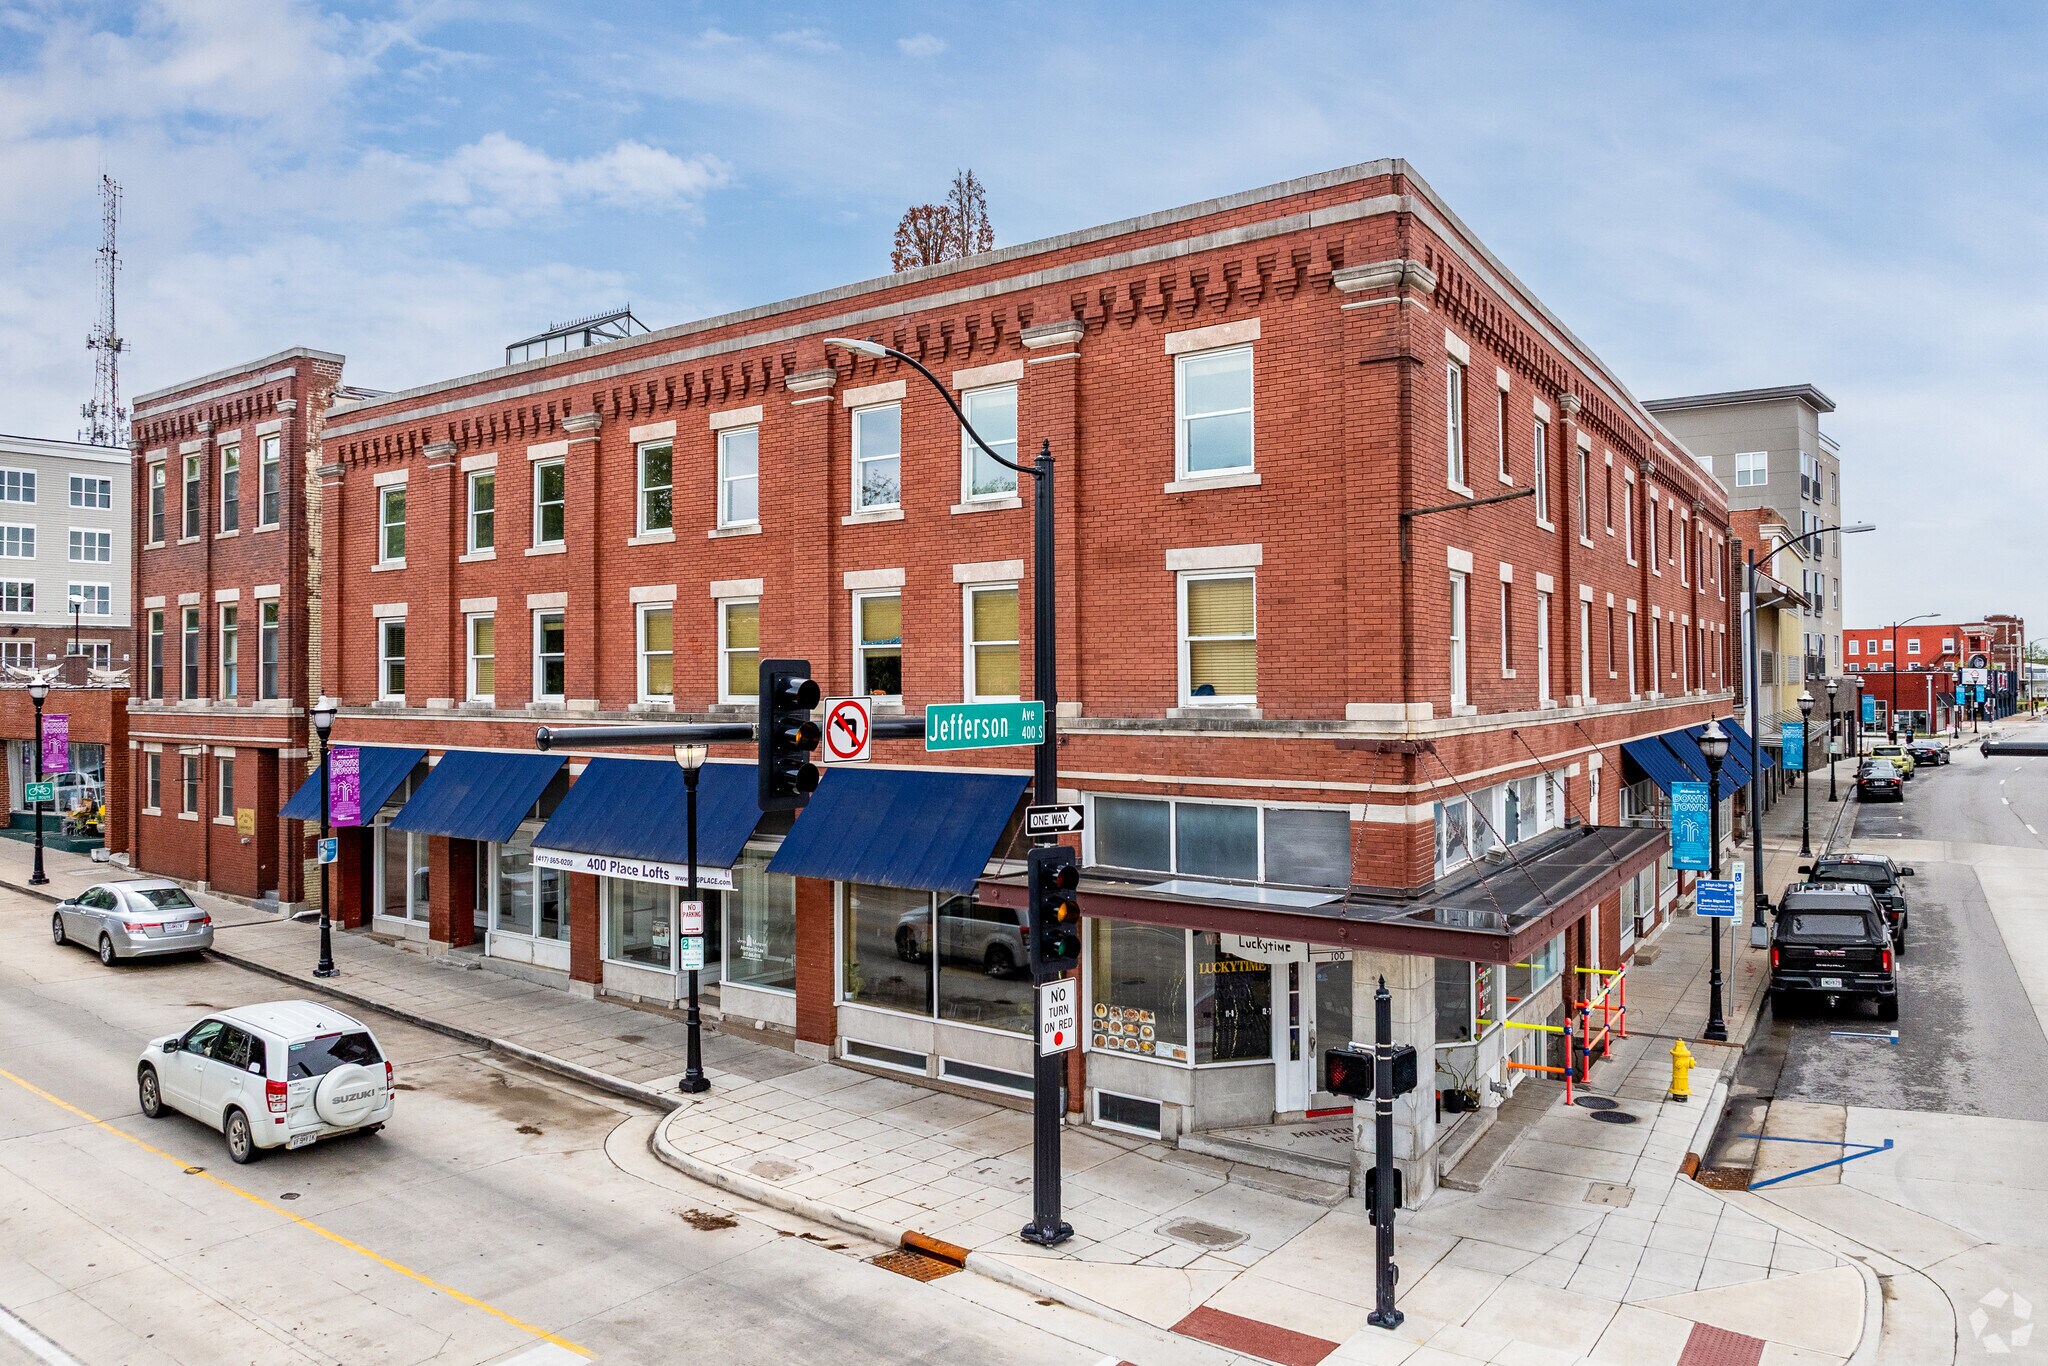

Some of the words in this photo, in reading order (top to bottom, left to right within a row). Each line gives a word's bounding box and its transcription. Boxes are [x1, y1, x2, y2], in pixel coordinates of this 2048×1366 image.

[929, 713, 1008, 742] Jefferson
[1022, 708, 1035, 721] Ave
[1022, 726, 1036, 739] 400
[1038, 725, 1043, 738] S
[331, 759, 359, 767] DOWN
[331, 767, 359, 775] TOWN
[1673, 794, 1708, 803] DOWN
[1673, 803, 1708, 812] TOWN
[1033, 815, 1049, 826] ONE
[1051, 813, 1068, 825] WAY
[535, 855, 549, 864] (417)
[587, 858, 607, 871] 400
[610, 861, 638, 876] Place
[642, 865, 670, 880] Lofts
[682, 939, 688, 949] 2
[1331, 951, 1345, 961] 100
[1199, 960, 1266, 974] LUCKYTIME
[1051, 988, 1066, 1003] NO
[1049, 1004, 1069, 1018] TURN
[1044, 1022, 1055, 1033] ON
[1058, 1017, 1073, 1030] RED
[332, 1089, 375, 1104] SUZUKI
